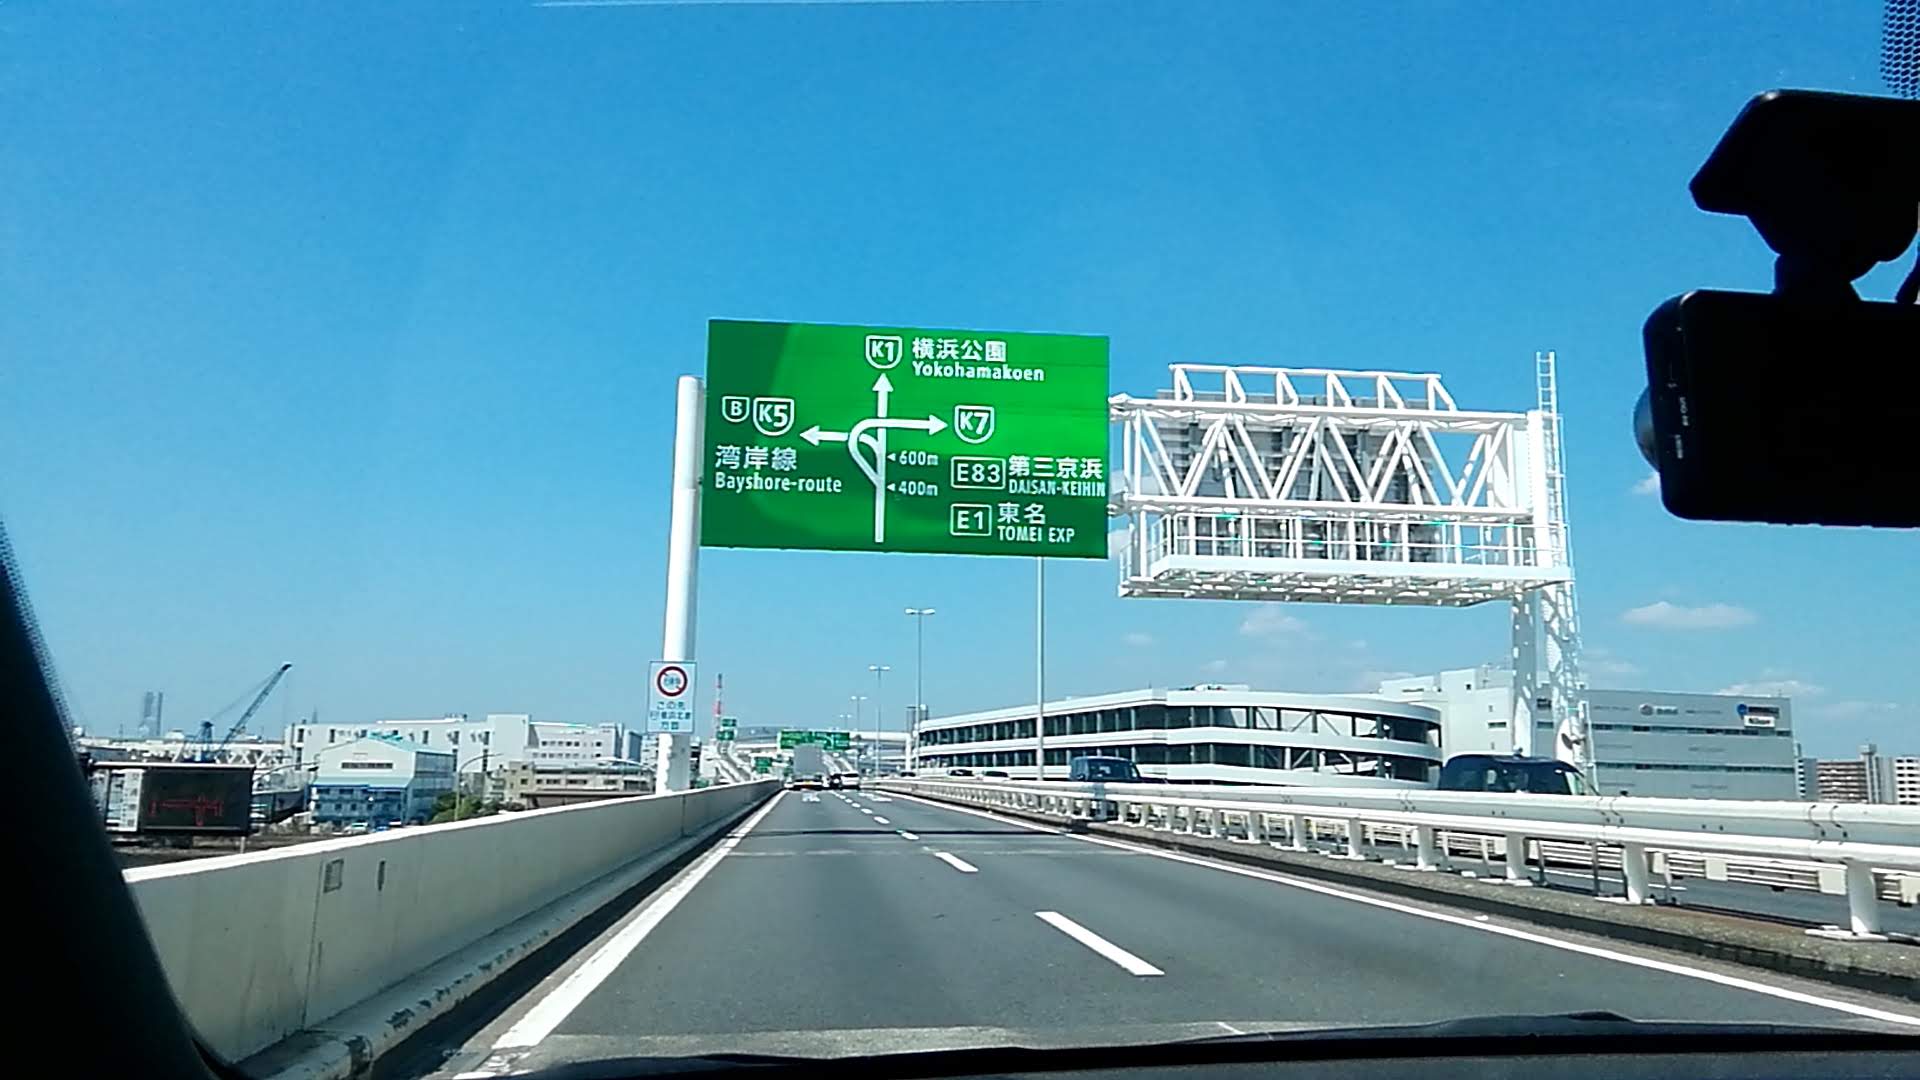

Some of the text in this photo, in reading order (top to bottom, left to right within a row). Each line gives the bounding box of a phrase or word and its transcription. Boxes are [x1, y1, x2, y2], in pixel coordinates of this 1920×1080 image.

[871, 340, 894, 362] K1
[912, 337, 1007, 362] 横浜公園
[912, 361, 1045, 382] Yokohamakoen
[730, 401, 788, 427] B K5
[960, 411, 989, 435] K7
[715, 445, 797, 471] 湾岸線
[899, 450, 939, 466] 600m
[1008, 455, 1103, 479] 第三京浜
[715, 472, 842, 493] Bayshore-route
[957, 463, 1000, 483] E83
[898, 481, 938, 496] 400m
[1009, 480, 1106, 497] DAISAN-KEIHIN
[957, 510, 984, 529] E1
[997, 502, 1046, 525] 東名
[997, 526, 1075, 543] TOMEI EXP
